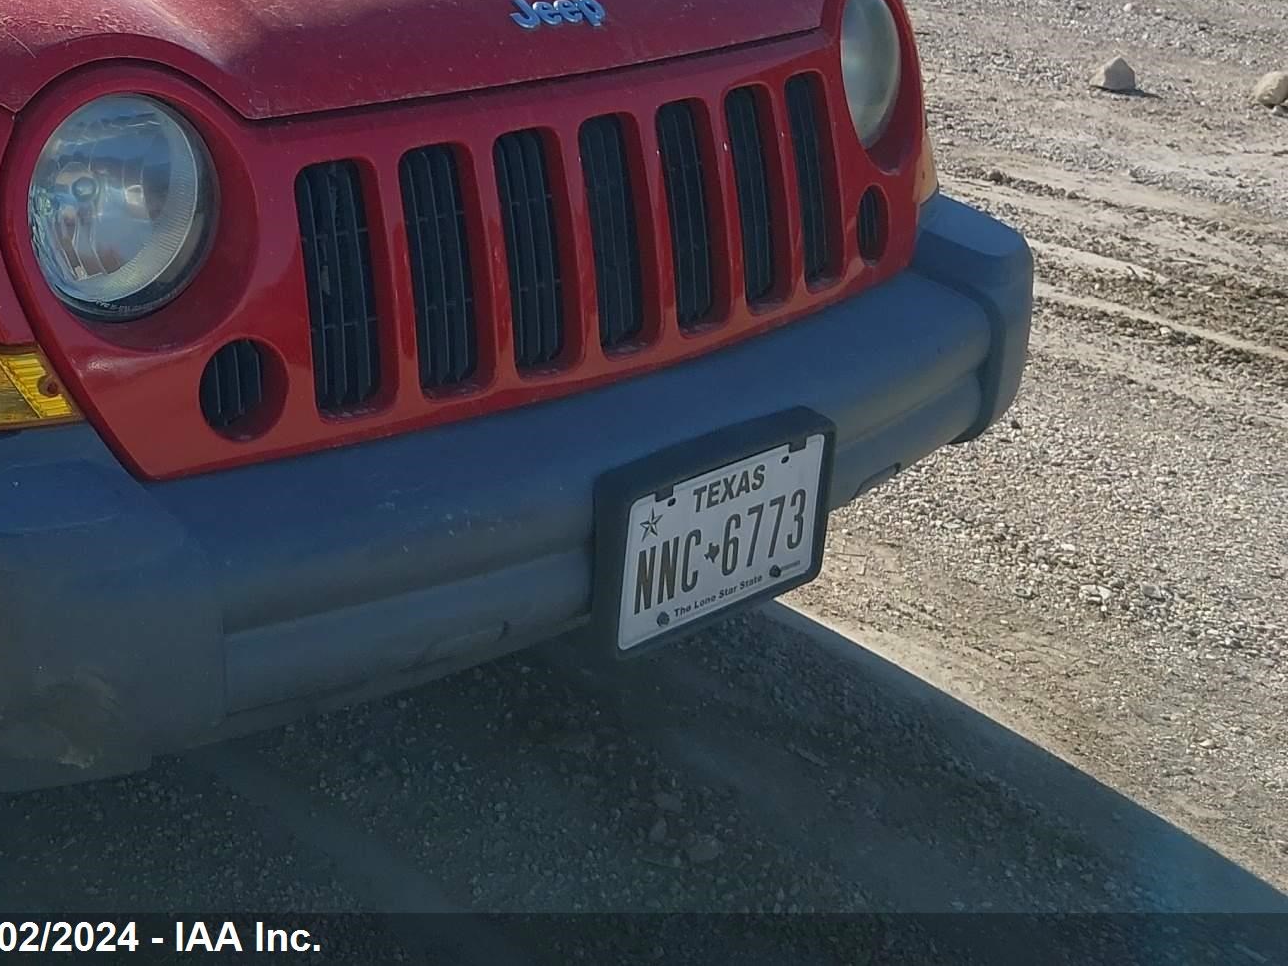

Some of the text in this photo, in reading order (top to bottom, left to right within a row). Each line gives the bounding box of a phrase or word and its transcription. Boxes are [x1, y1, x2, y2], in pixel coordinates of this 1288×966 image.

[693, 464, 765, 513] TEXAS
[634, 488, 806, 615] NNC 6773
[674, 575, 762, 617] The Lone Star State
